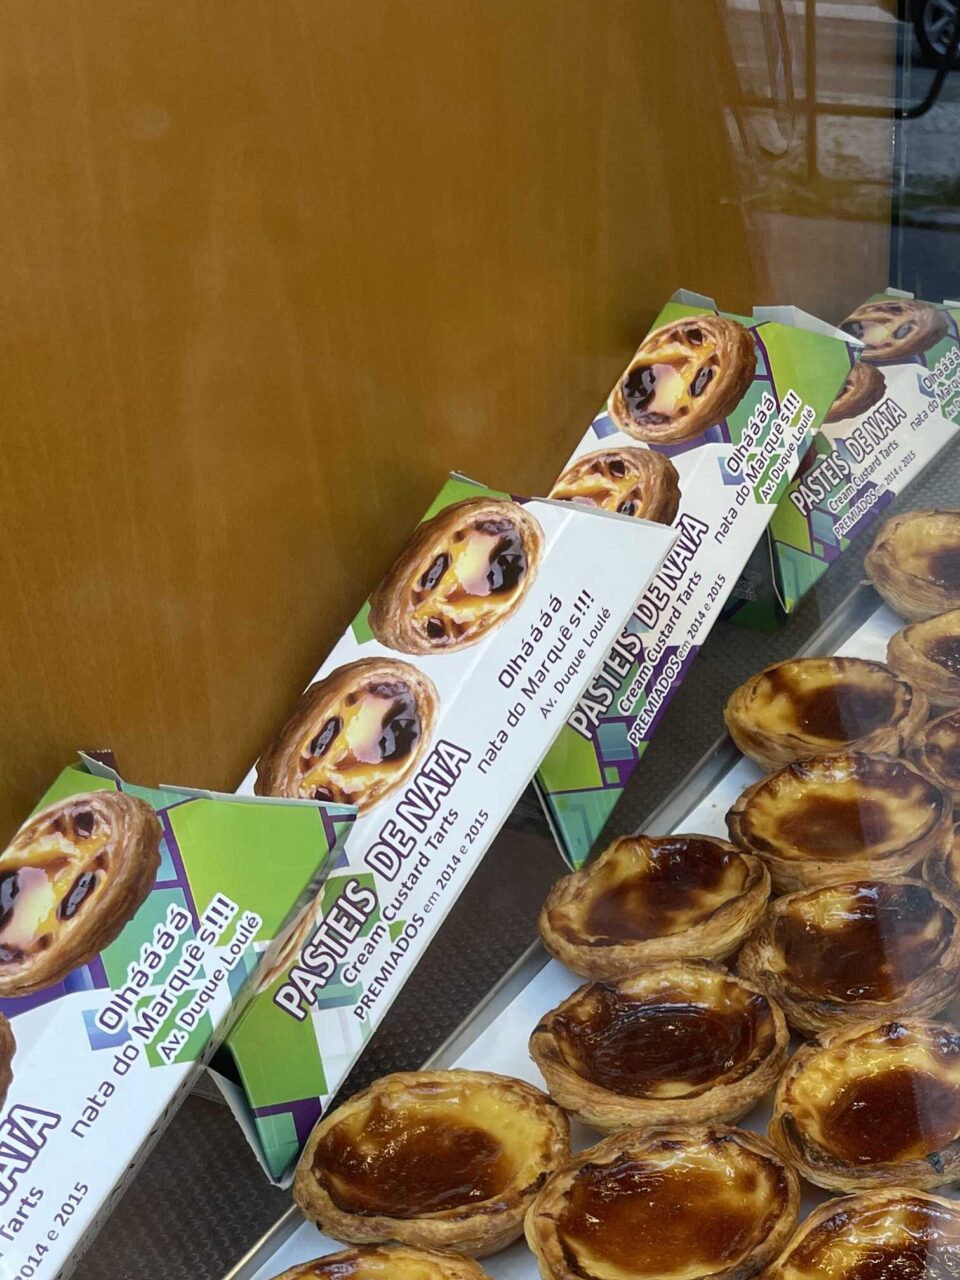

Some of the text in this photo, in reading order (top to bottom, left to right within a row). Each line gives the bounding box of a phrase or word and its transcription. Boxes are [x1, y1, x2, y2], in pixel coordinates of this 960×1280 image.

[761, 409, 813, 500] Av. Duque Loulé
[789, 398, 907, 517] PASTEIS DE NATA
[910, 410, 928, 431] nata
[928, 400, 938, 413] do
[715, 507, 737, 544] nata
[736, 485, 750, 506] do
[828, 440, 898, 511] Cream Custard Tarts
[834, 490, 876, 537] PREMIADOS
[884, 469, 898, 484] 2014
[902, 451, 916, 466] 2015
[634, 583, 670, 631] DE
[662, 513, 709, 591] NATA
[540, 607, 611, 719] Av. Duque Loulé
[620, 571, 701, 713] Cream Custard Tarts
[629, 575, 726, 745] PREMIADOS em 2014 e 2015
[478, 730, 508, 774] nata
[507, 702, 525, 727] do
[273, 740, 471, 1022] PASTEIS DE NATA
[343, 808, 459, 984] Cream Custard Tarts
[354, 810, 489, 1020] PREMIADOS em 2014 e 2015
[160, 915, 259, 1060] Av. Duque Loulé
[71, 1081, 115, 1138] nata
[113, 1045, 139, 1076] do
[0, 1104, 61, 1206] ATA
[48, 1229, 59, 1241] e
[54, 1182, 88, 1226] 2015
